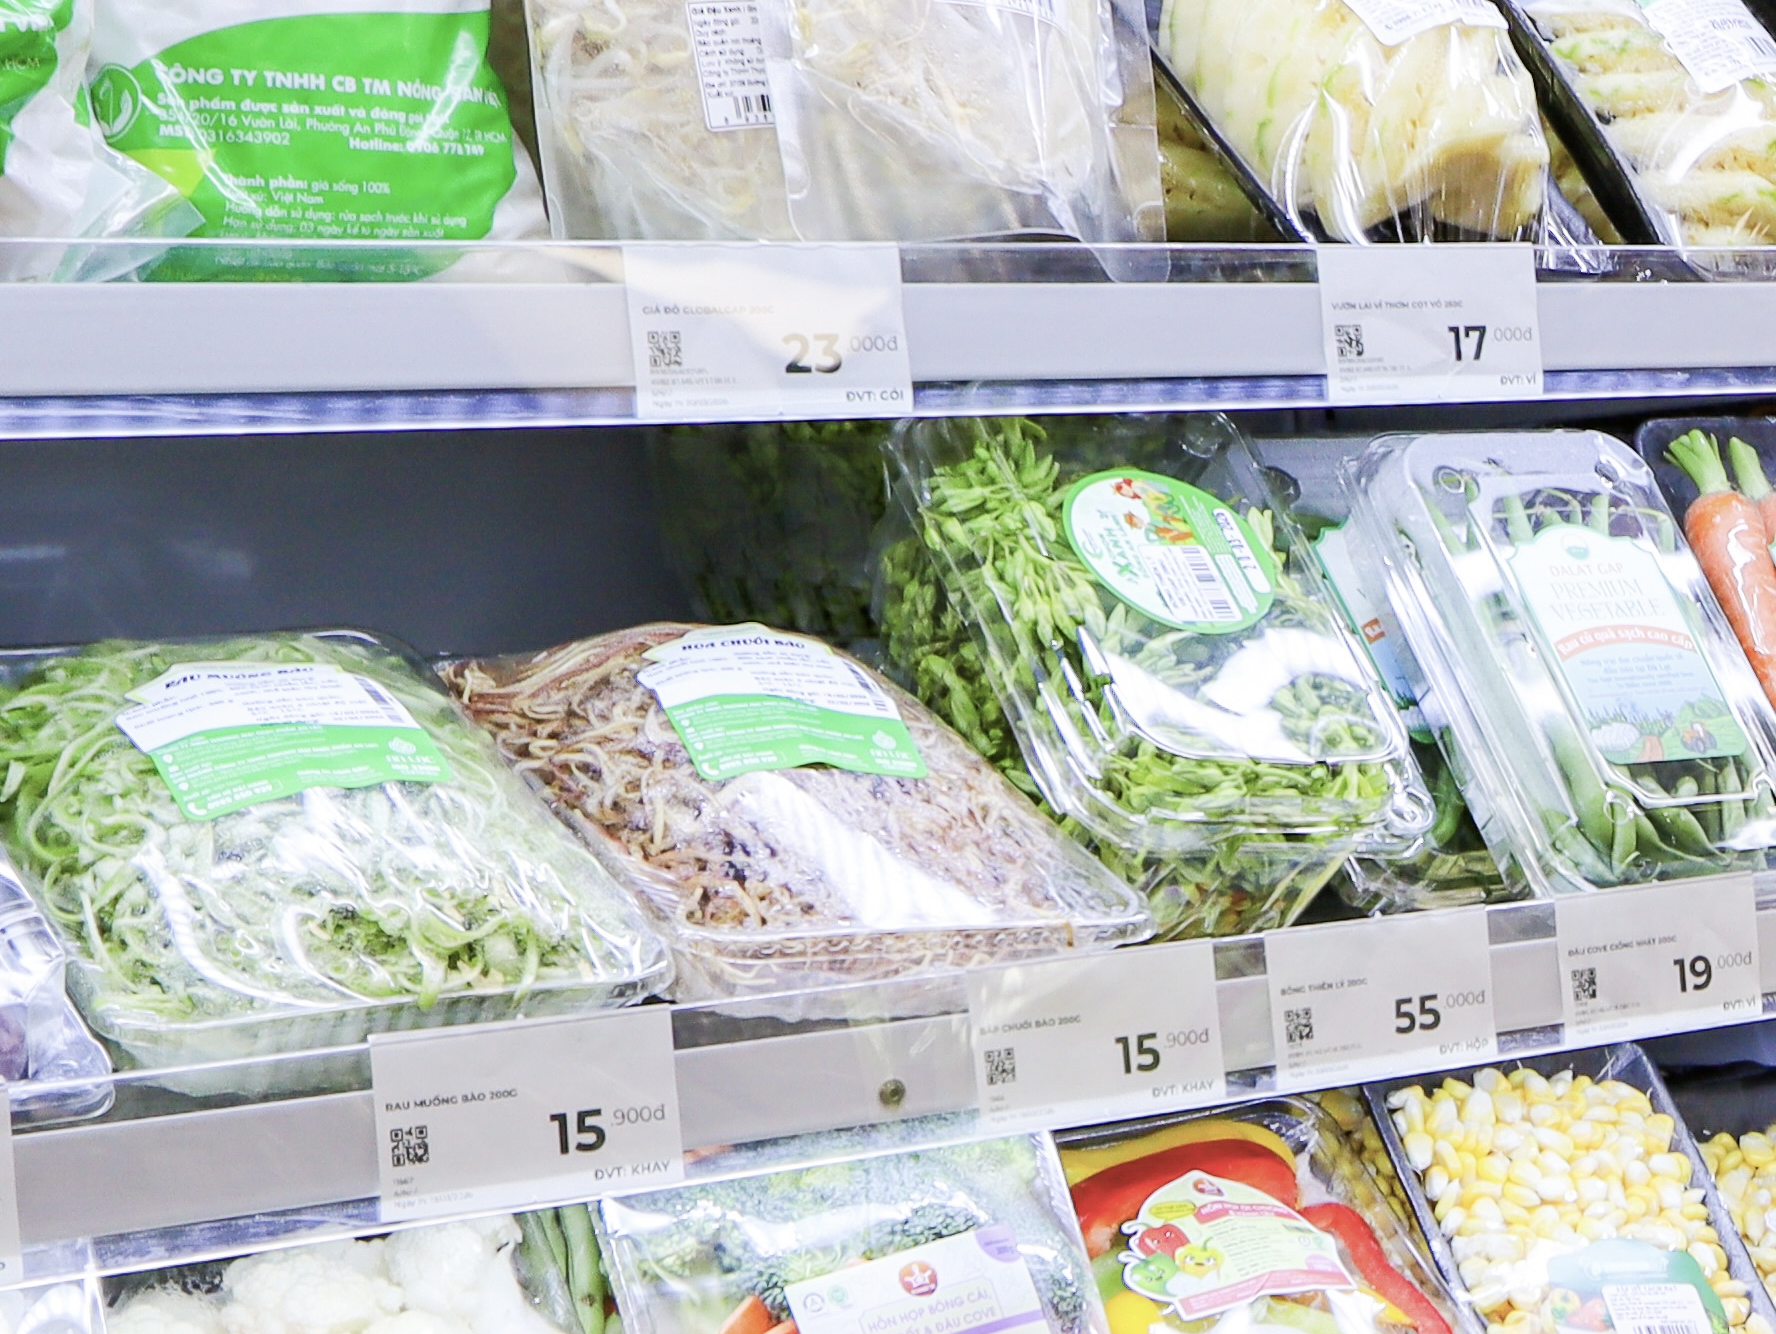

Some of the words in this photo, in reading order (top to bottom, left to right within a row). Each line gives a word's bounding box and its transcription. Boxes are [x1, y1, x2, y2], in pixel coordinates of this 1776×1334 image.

[231, 69, 257, 87] TY
[264, 70, 326, 92] TNHH
[331, 73, 358, 94] CB
[361, 76, 392, 97] TM
[384, 1100, 412, 1113] RAU
[630, 1160, 672, 1178] KHAY
